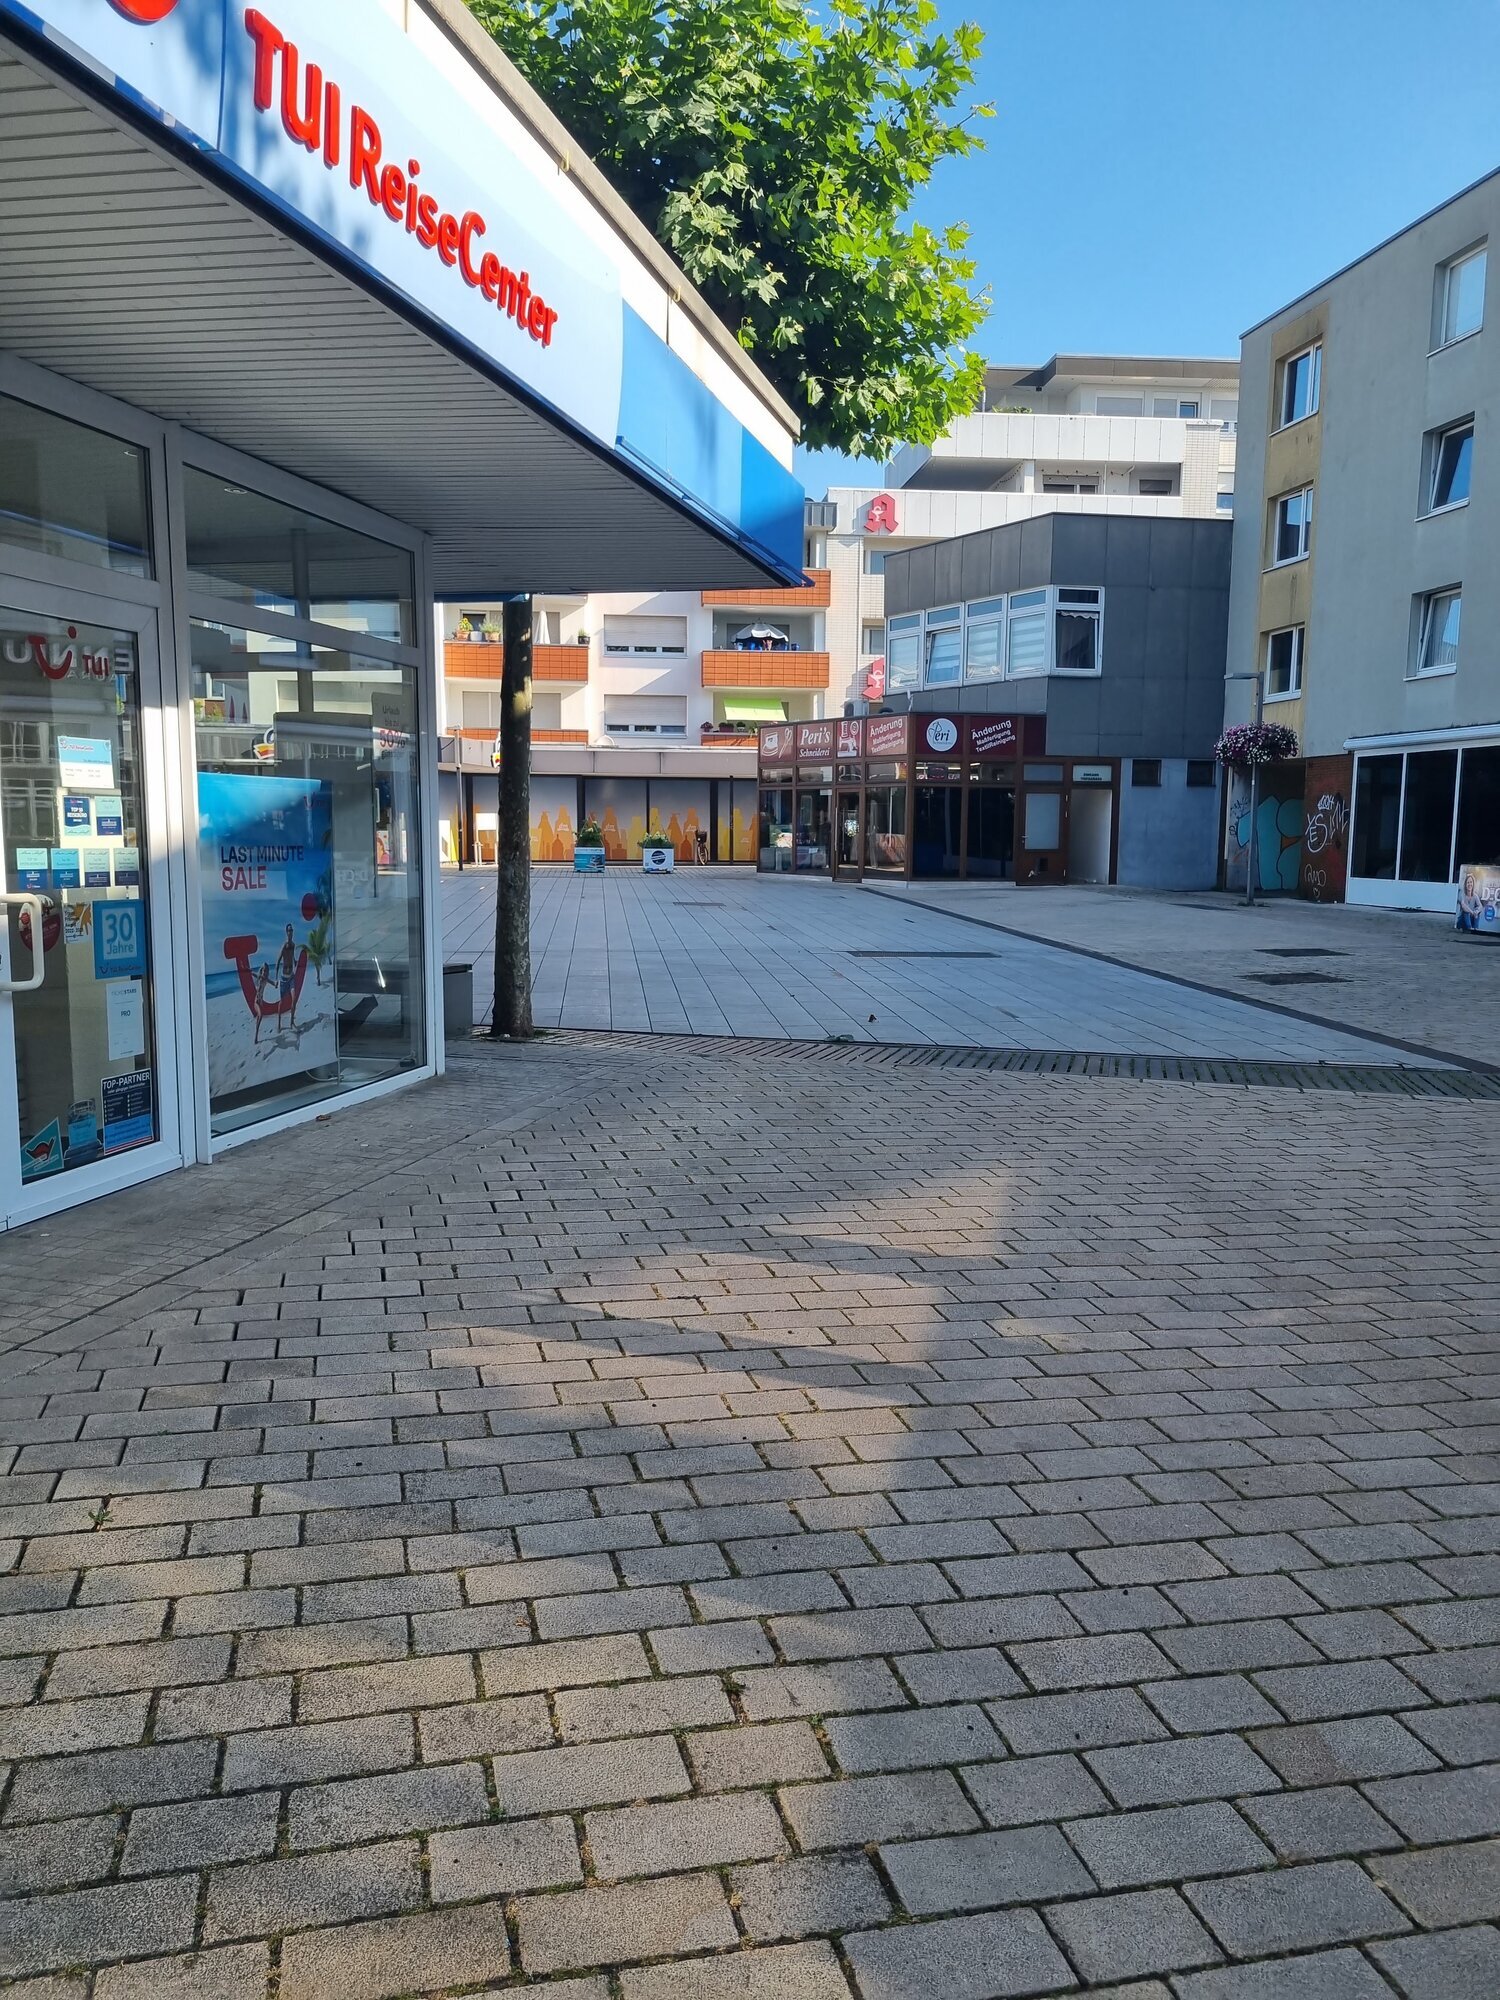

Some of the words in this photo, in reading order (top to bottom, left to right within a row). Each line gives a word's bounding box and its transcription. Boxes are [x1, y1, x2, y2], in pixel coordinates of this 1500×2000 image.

[244, 8, 340, 168] TUI
[351, 105, 558, 347] ReiseCenter
[82, 654, 110, 676] TUI
[800, 727, 831, 745] Peri's
[869, 718, 903, 737] Änderung
[971, 720, 1012, 740] Änderung
[379, 729, 406, 749] 50%
[799, 747, 831, 758] Schneiderei
[221, 845, 253, 864] LAST
[257, 845, 304, 862] MINUTE
[222, 866, 267, 891] SALE
[105, 912, 132, 945] 30
[106, 942, 134, 956] Jahre
[103, 1072, 150, 1090] TOP-PARTNER
